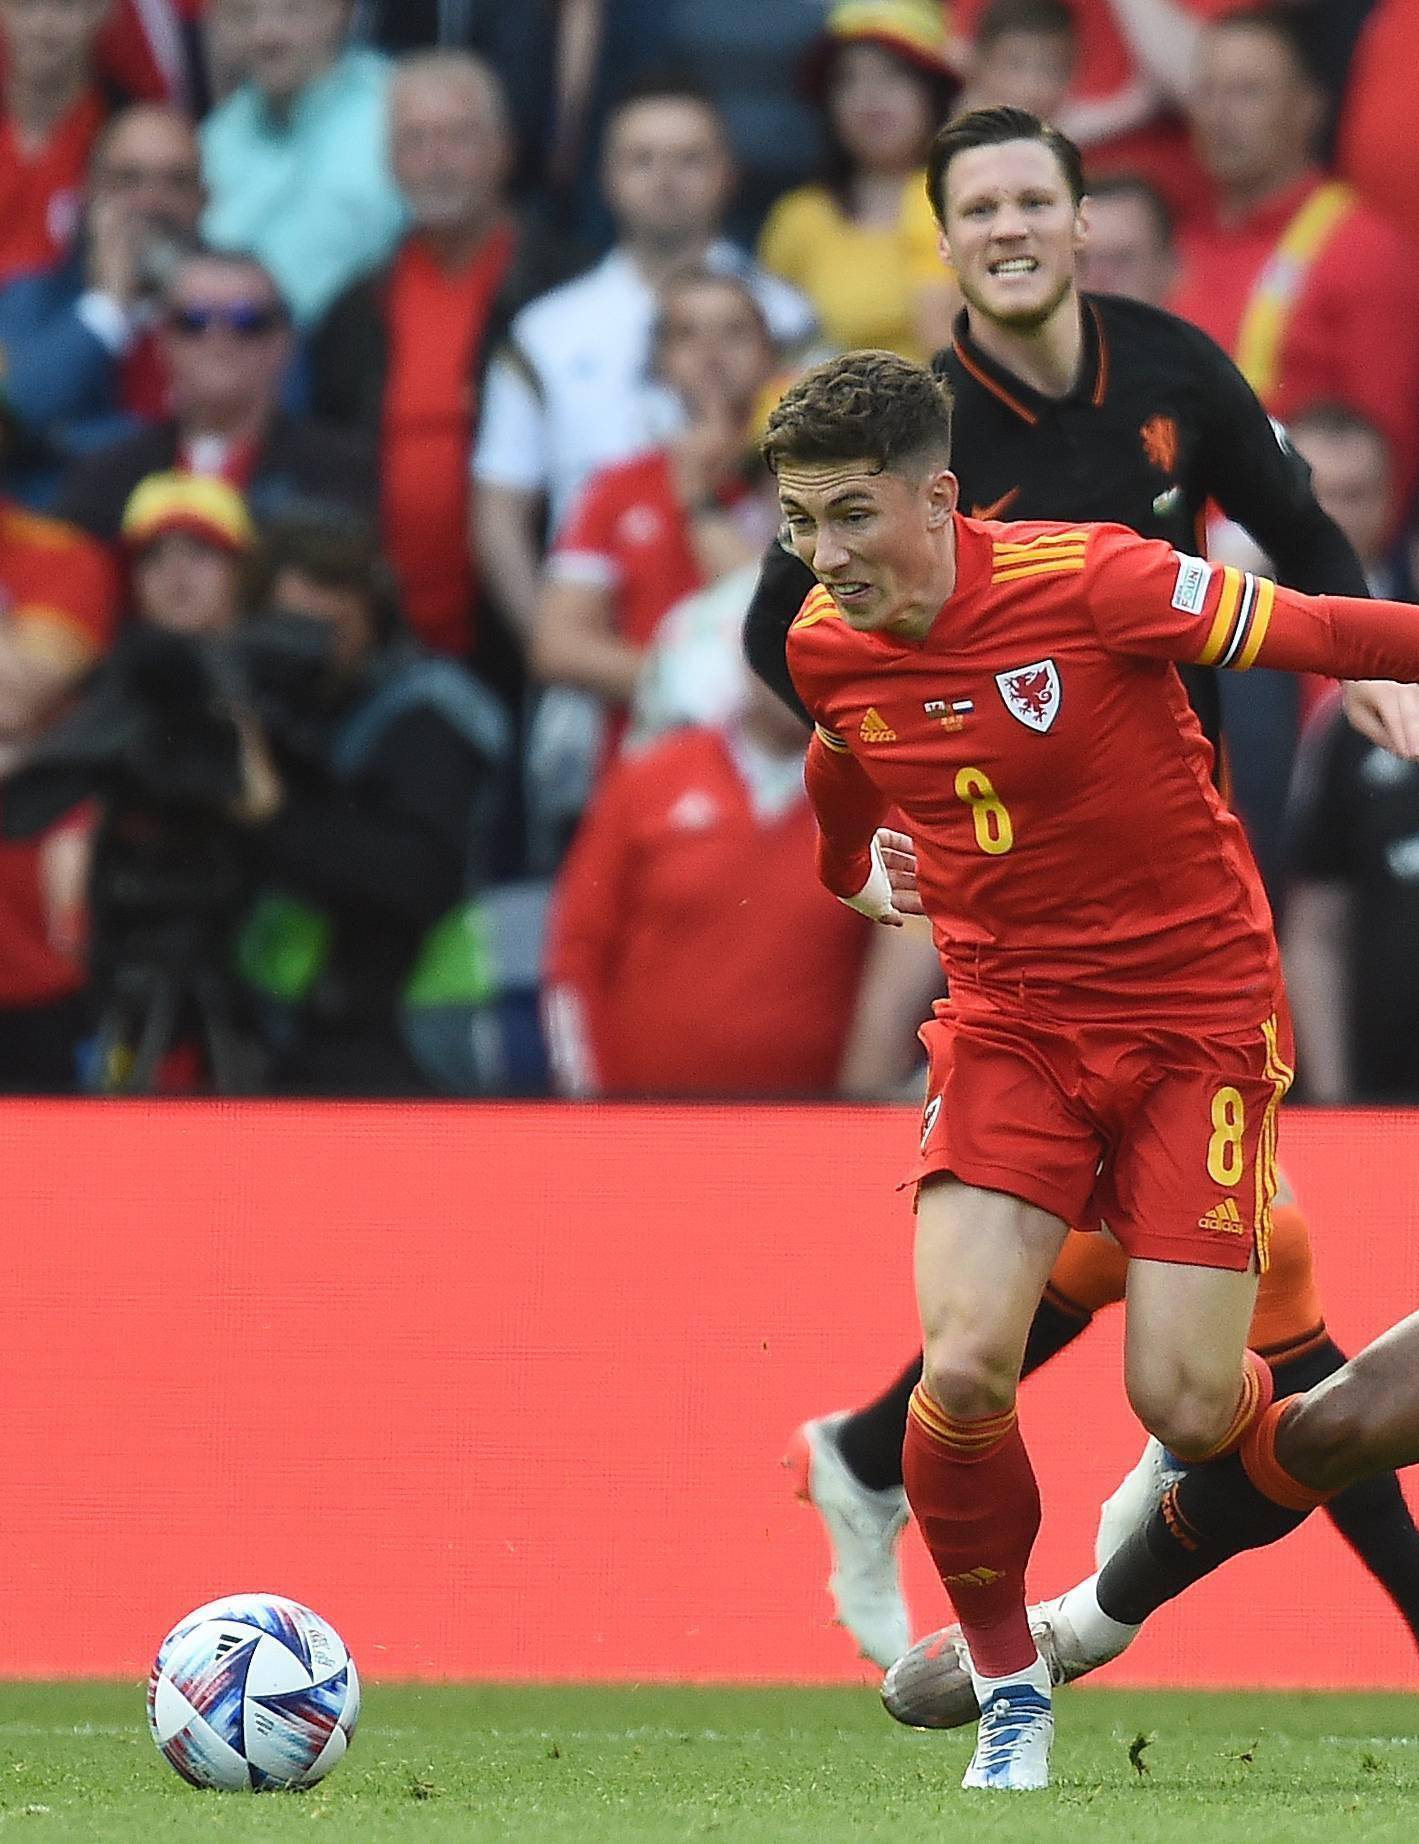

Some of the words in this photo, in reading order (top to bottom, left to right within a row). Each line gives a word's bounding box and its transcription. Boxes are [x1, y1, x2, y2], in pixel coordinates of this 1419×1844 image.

[955, 767, 1013, 854] 8
[1207, 1086, 1244, 1187] 8
[1199, 1218, 1243, 1235] adidas
